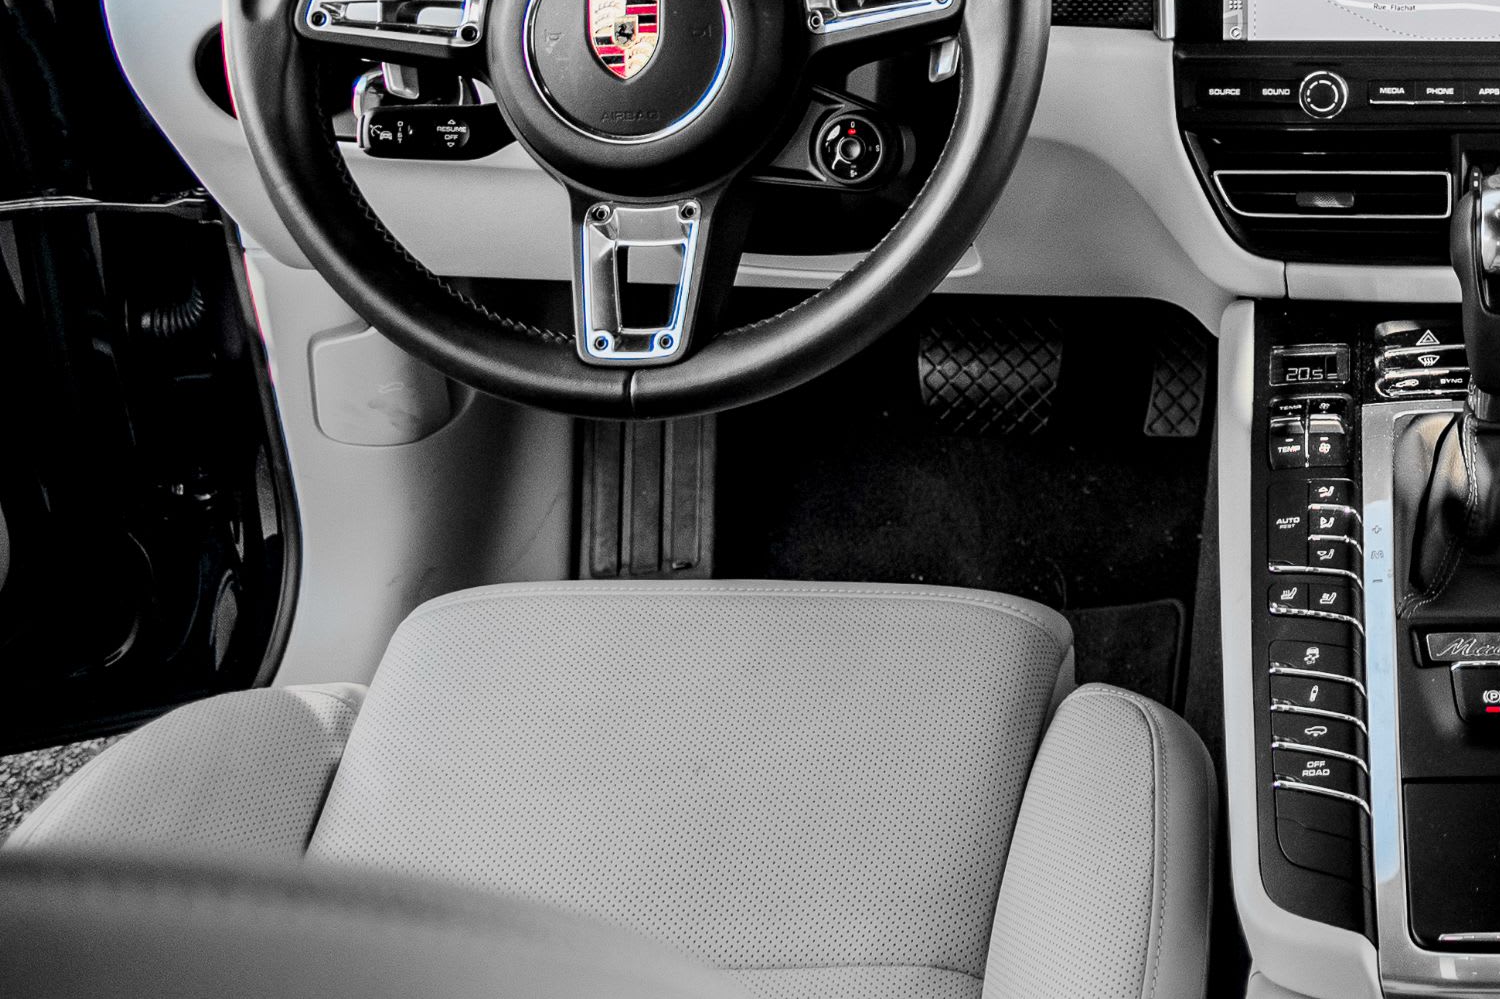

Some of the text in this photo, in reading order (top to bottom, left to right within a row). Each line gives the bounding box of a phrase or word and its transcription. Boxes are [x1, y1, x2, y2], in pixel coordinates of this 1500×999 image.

[1208, 88, 1241, 96] SOURCE
[1262, 88, 1290, 96] SOUND
[1379, 87, 1405, 95] MEDIA
[1426, 87, 1454, 95] PHONE
[1478, 87, 1500, 96] APPS
[1286, 367, 1323, 381] 20.5
[1278, 445, 1301, 453] TEMP
[1276, 517, 1300, 525] AUTO
[1302, 769, 1330, 777] ROAD
